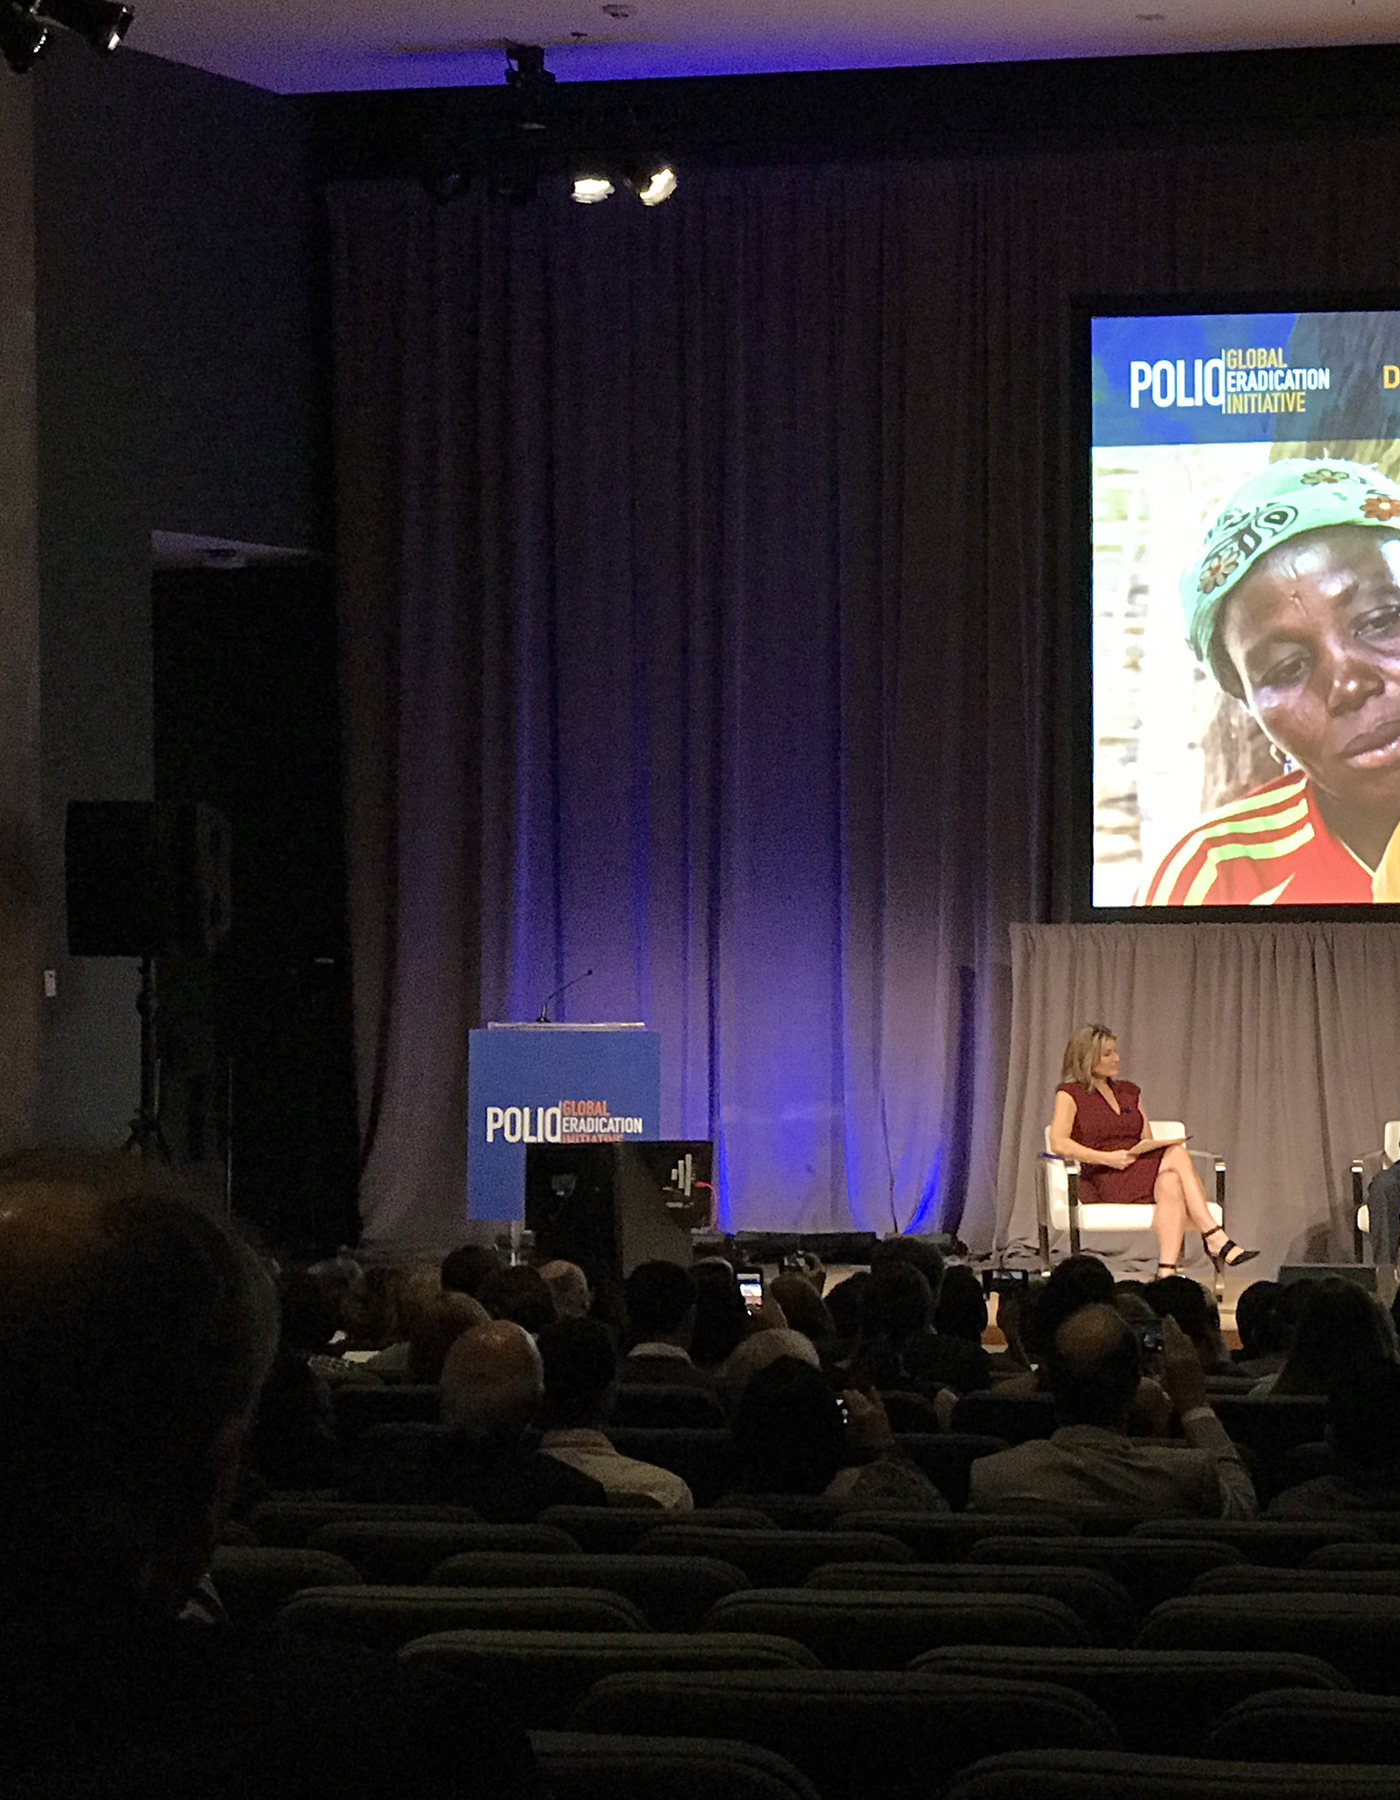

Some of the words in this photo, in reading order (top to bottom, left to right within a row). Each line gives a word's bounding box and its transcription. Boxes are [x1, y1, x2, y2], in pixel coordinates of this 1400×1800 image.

[1227, 347, 1287, 369] GLOBAL
[1130, 358, 1225, 408] POLIO
[1226, 368, 1330, 392] ERADICATION
[1227, 391, 1306, 414] INITIATIVE
[562, 1100, 611, 1116] GLOBAL
[486, 1107, 561, 1143] POLIO
[562, 1116, 643, 1134] ERADICATION
